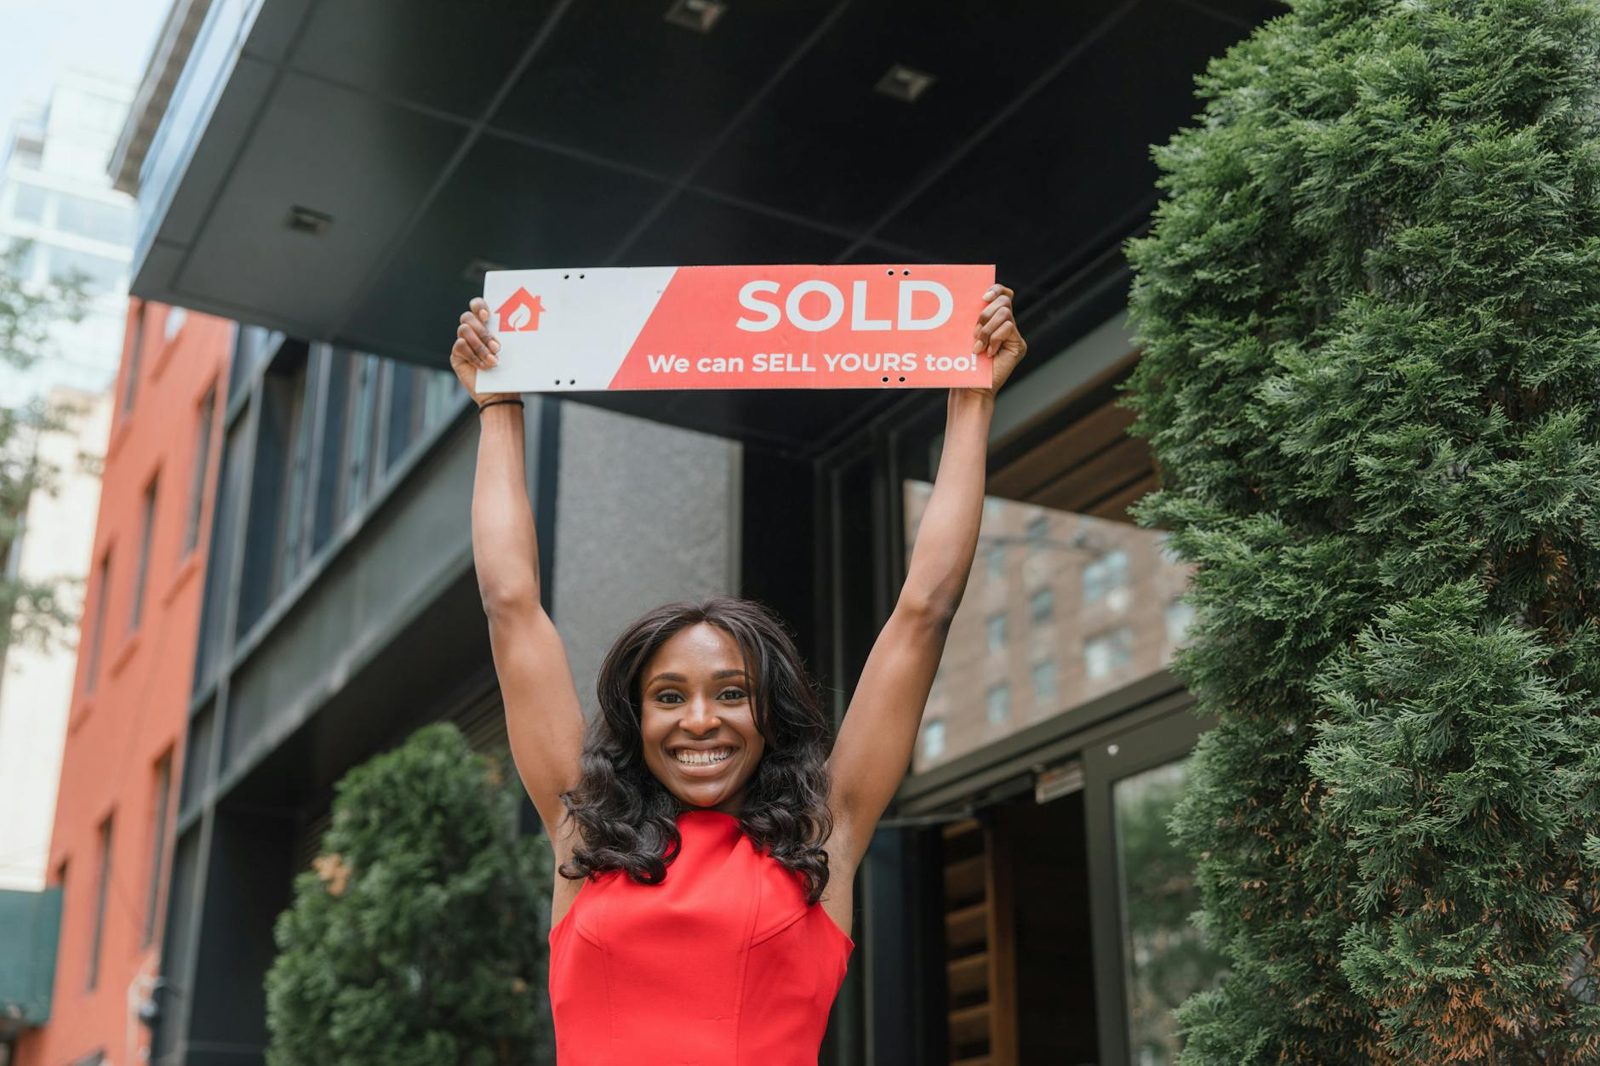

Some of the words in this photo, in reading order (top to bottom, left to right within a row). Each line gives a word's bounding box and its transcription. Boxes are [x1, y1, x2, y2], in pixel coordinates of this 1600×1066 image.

[736, 280, 954, 332] SOLD
[648, 355, 690, 373] We
[697, 358, 744, 373] can
[752, 354, 816, 372] SELL
[824, 353, 918, 372] YOURS
[924, 353, 978, 373] too!
